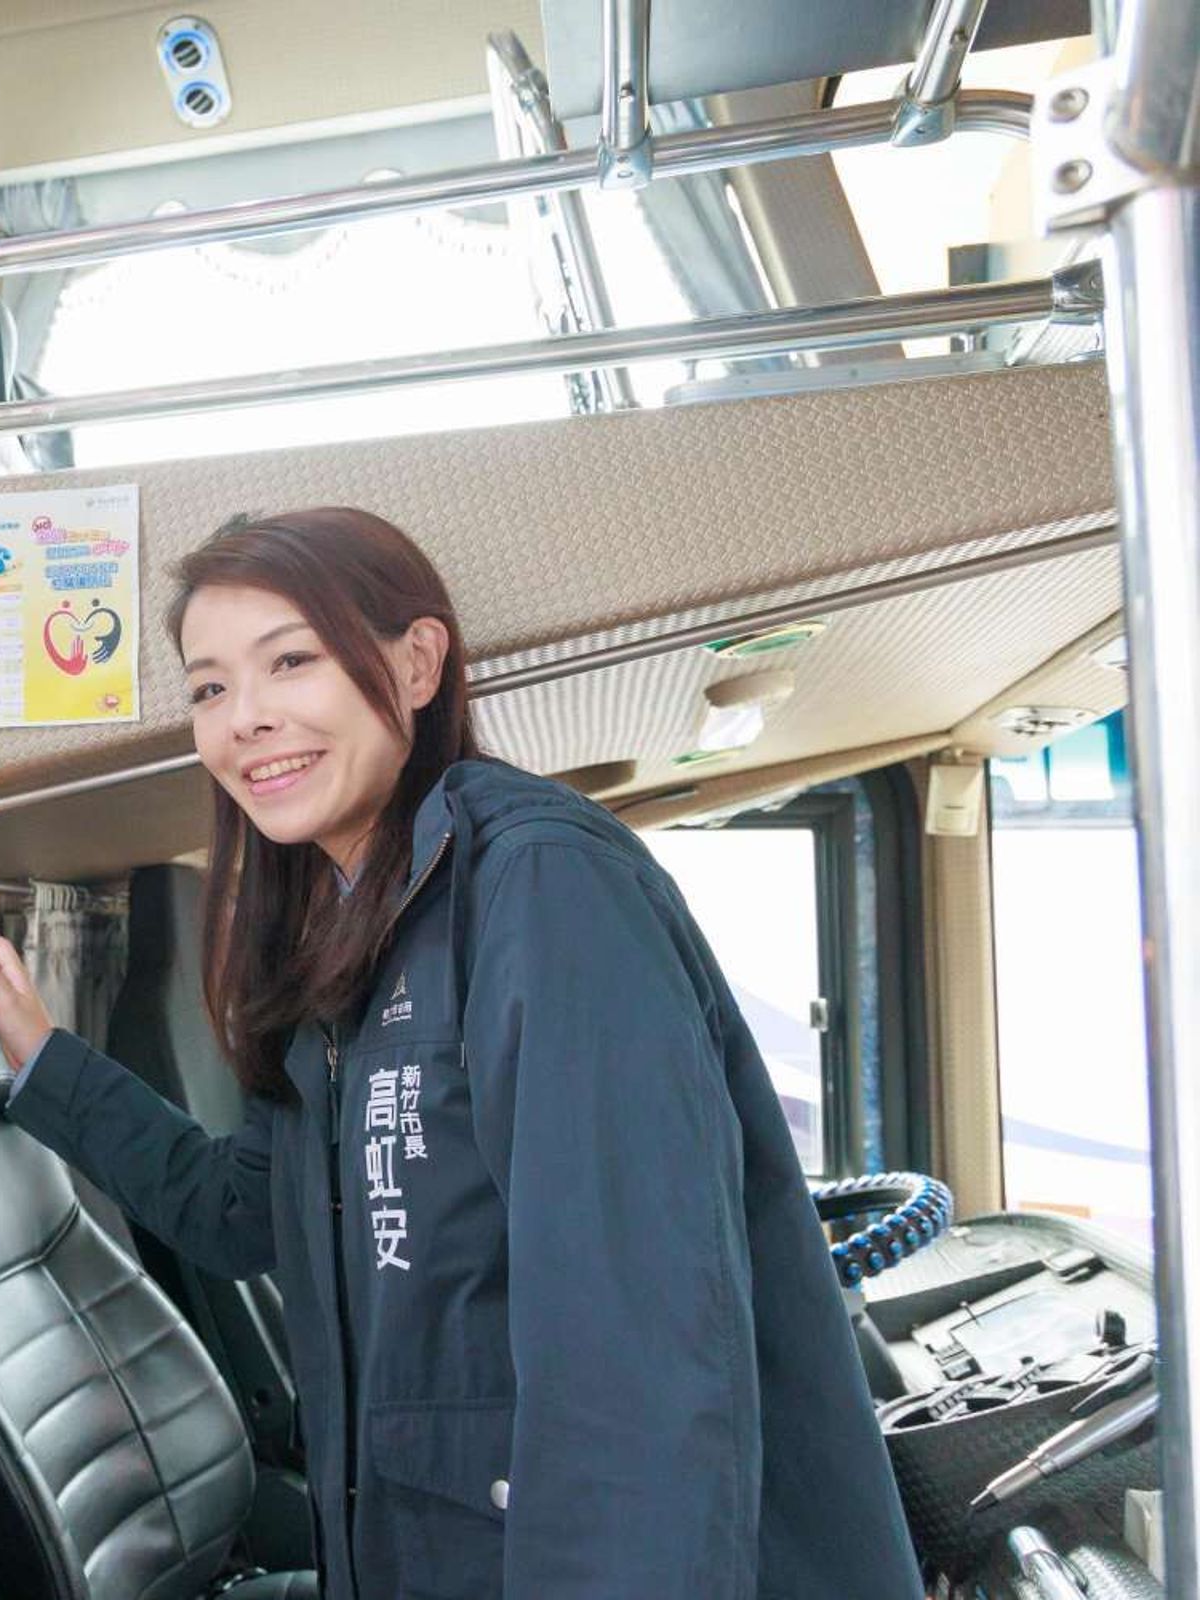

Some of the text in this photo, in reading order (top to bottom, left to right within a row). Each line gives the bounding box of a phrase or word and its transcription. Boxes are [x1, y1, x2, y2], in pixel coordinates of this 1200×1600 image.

[365, 1068, 411, 1271] 高虹安
[400, 1064, 428, 1160] 新竹市長
